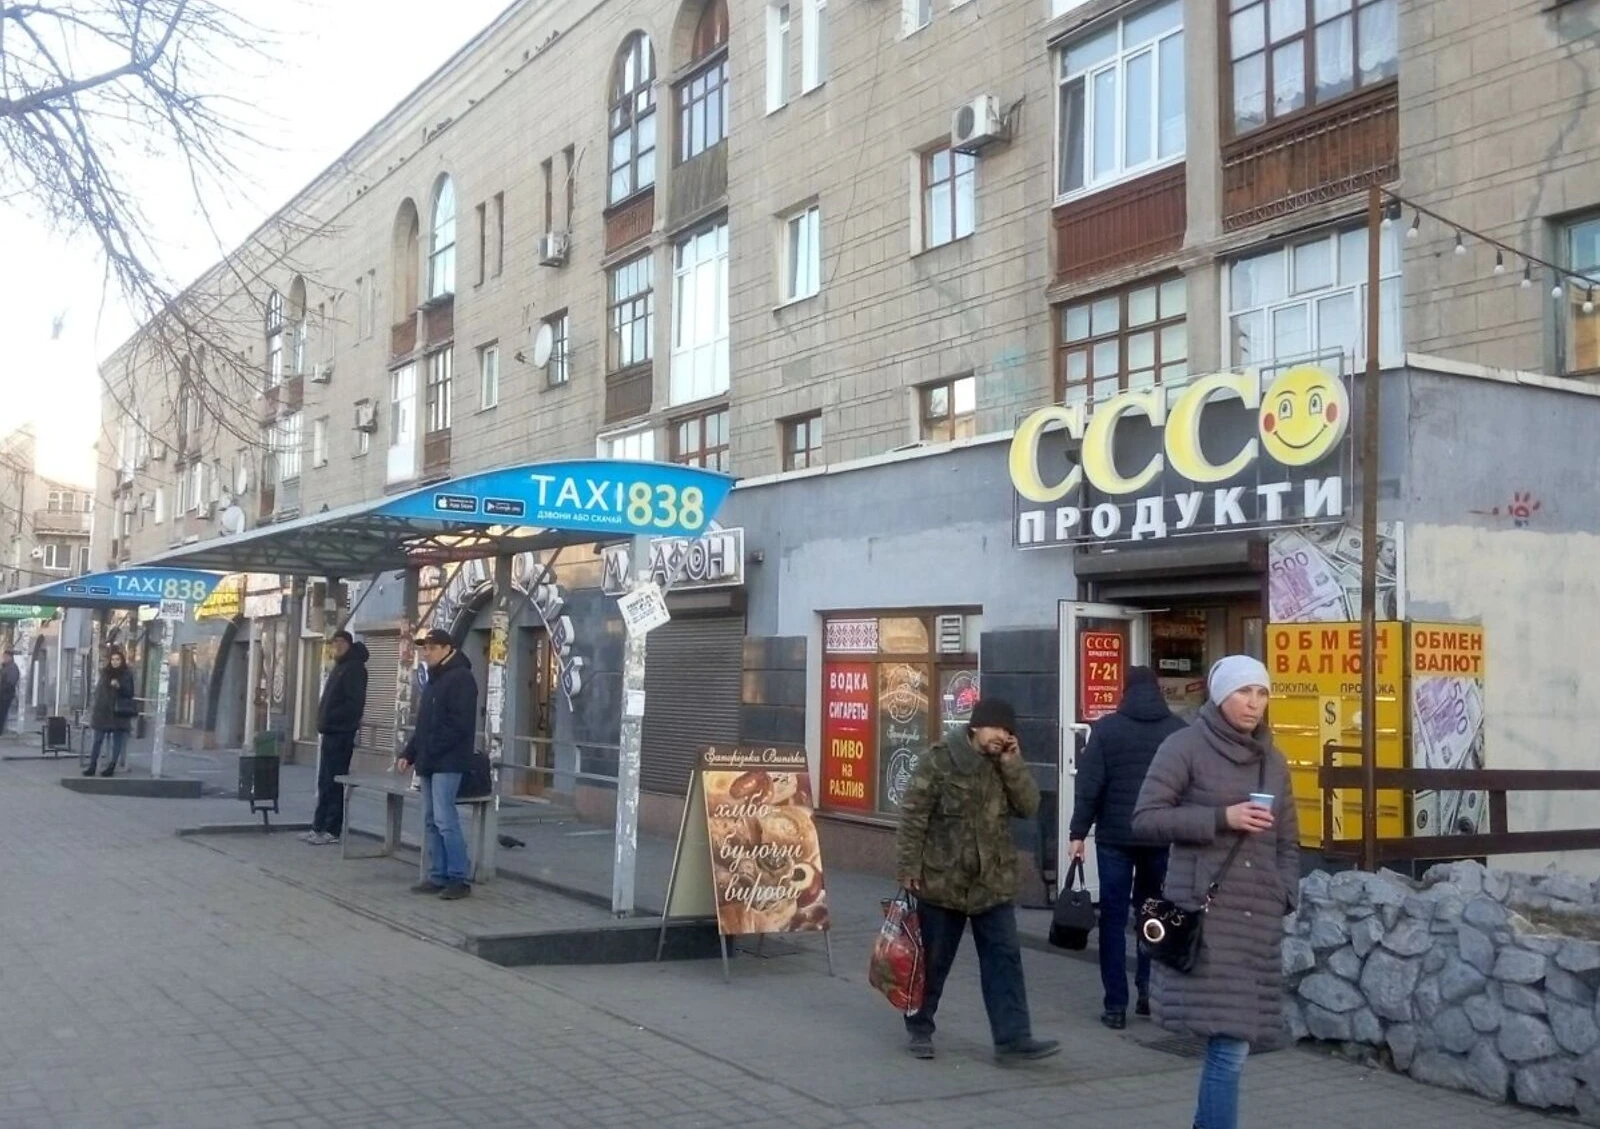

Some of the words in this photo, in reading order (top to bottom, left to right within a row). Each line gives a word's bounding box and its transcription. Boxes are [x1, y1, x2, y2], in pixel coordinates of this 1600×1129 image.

[537, 510, 571, 520] ДЗВОНИ
[573, 513, 589, 522] АБО
[591, 514, 622, 525] СКАЧАЙ
[1019, 476, 1343, 543] ПРОДУКТИ
[1275, 628, 1388, 650] ОБМЕН
[1415, 630, 1482, 650] ОБМЕН
[1089, 662, 1118, 681] 7-21
[1276, 653, 1388, 674] ВАЛЮТ
[1415, 652, 1482, 673] ВАЛЮТ
[829, 672, 869, 694] ВОДКА
[1271, 682, 1319, 693] ПОКУПКА
[1094, 692, 1114, 703] 7-19
[828, 701, 869, 720] СИГАРЕТЫ
[831, 738, 864, 759] ПИВО
[841, 764, 853, 777] на
[829, 781, 864, 799] РАЗЛИВ
